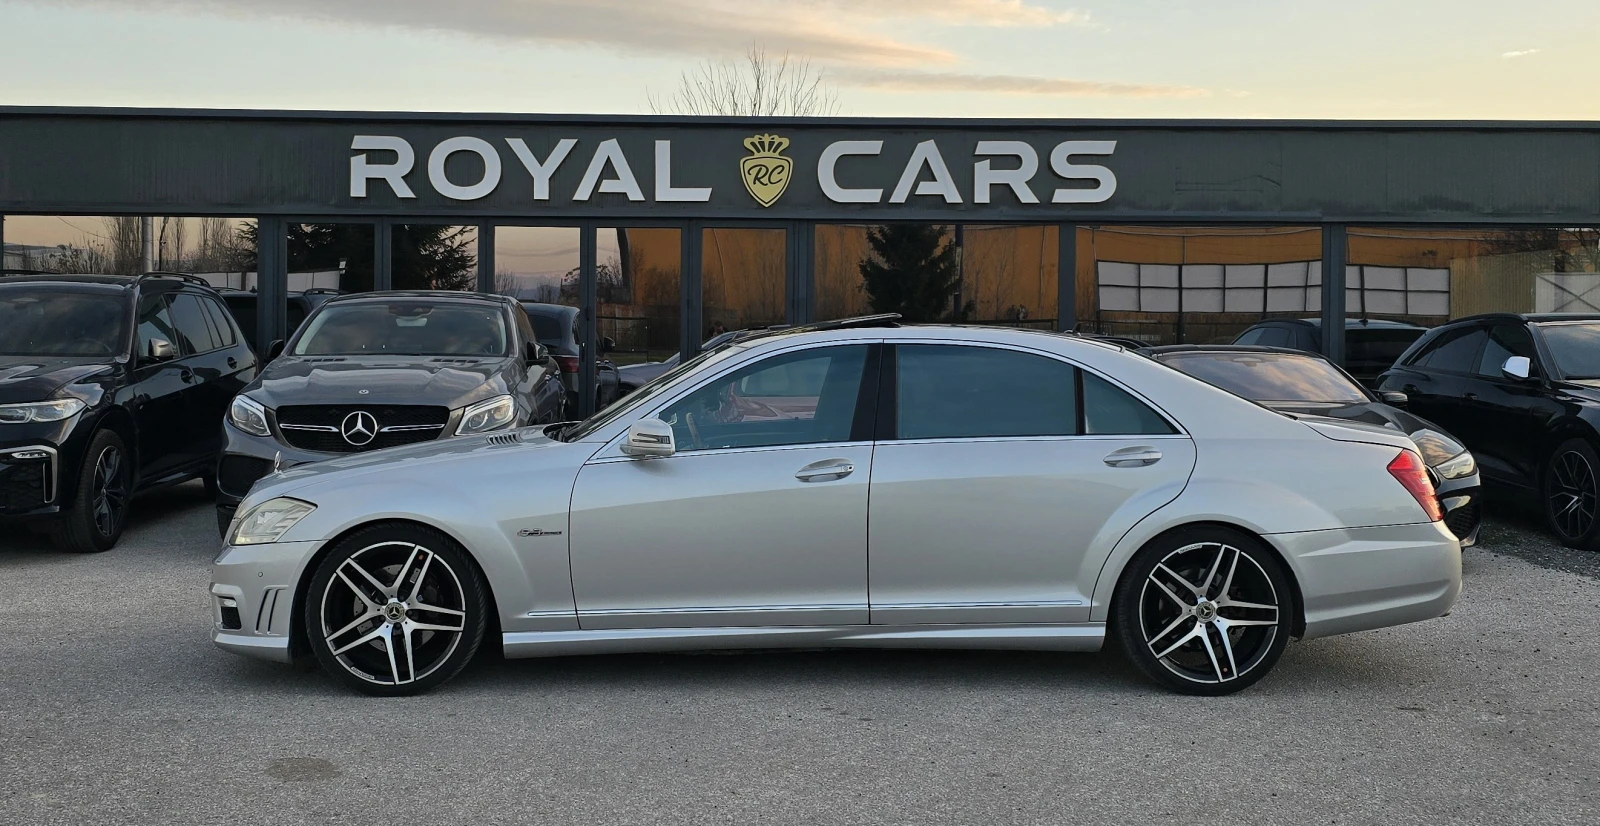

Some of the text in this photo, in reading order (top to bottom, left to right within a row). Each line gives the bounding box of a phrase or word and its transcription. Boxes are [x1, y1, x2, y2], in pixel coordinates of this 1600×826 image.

[350, 135, 1118, 204] ROYAL CARS
[747, 163, 785, 186] RC
